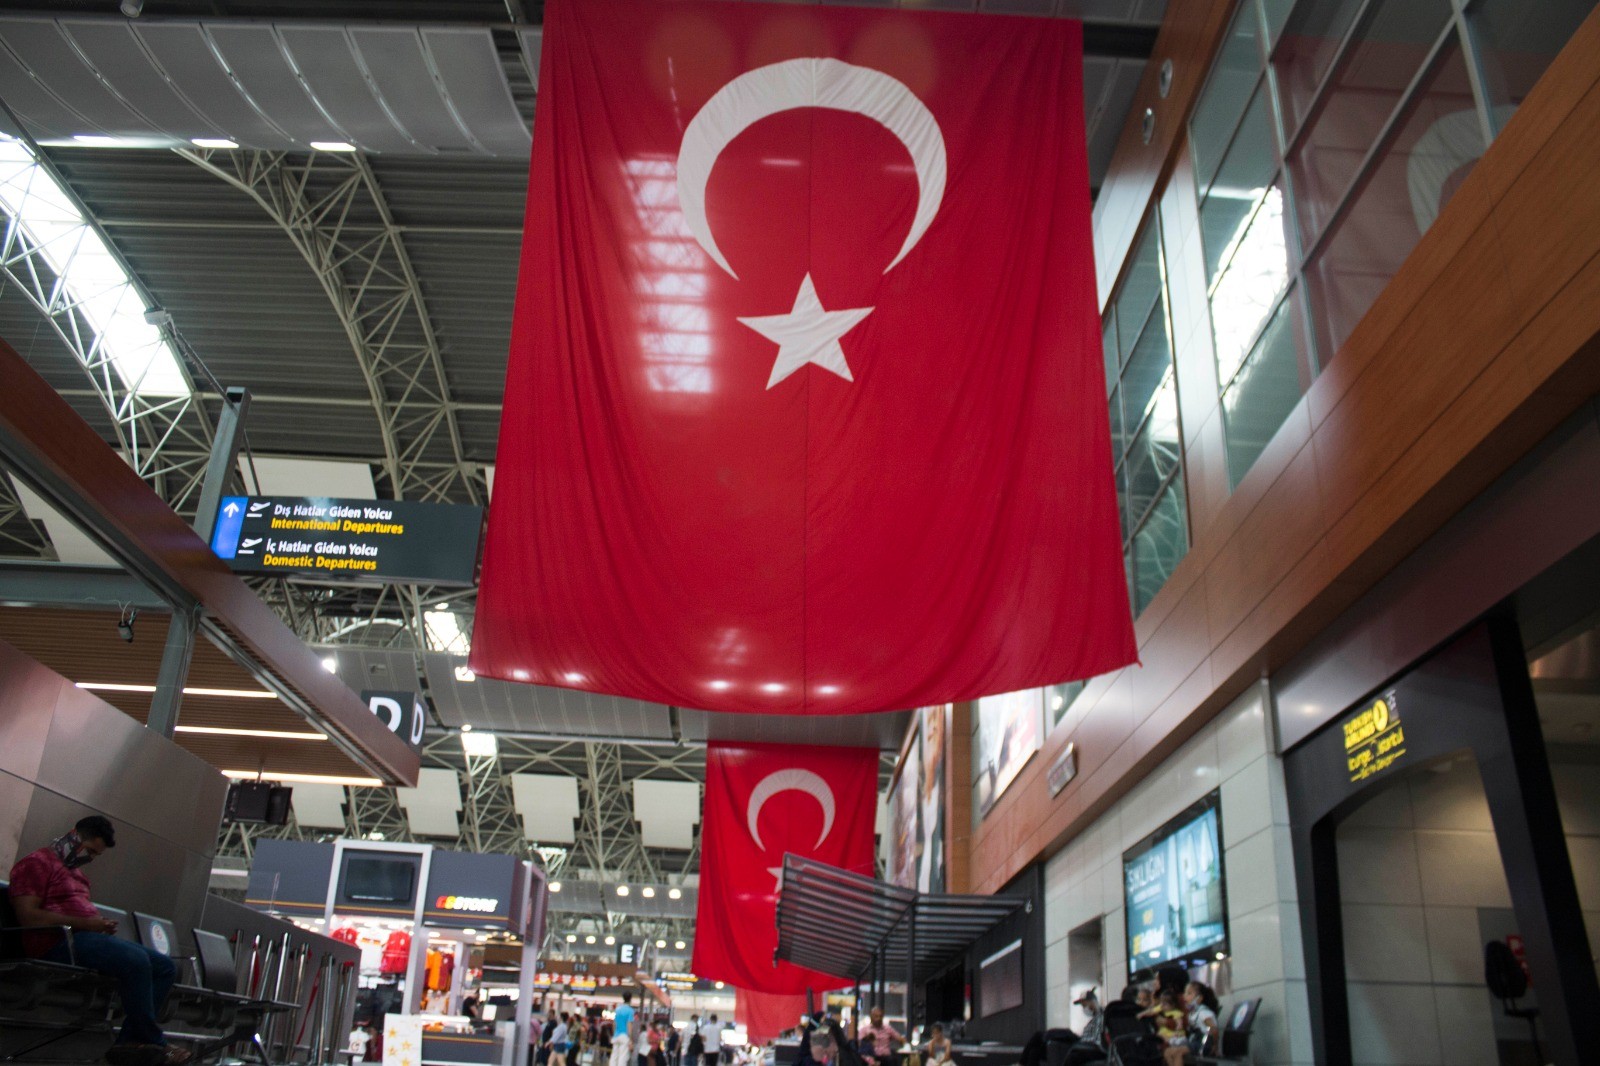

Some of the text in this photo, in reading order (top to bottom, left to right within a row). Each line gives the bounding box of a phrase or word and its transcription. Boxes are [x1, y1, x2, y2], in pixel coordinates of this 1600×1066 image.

[274, 504, 393, 520] Dış Hatlar Giden Yolcu
[271, 518, 404, 535] International Departures
[266, 538, 378, 556] İç Hatlar Giden Yolcu
[263, 554, 377, 571] Domestic Departures
[411, 702, 424, 745] D
[620, 944, 634, 963] E
